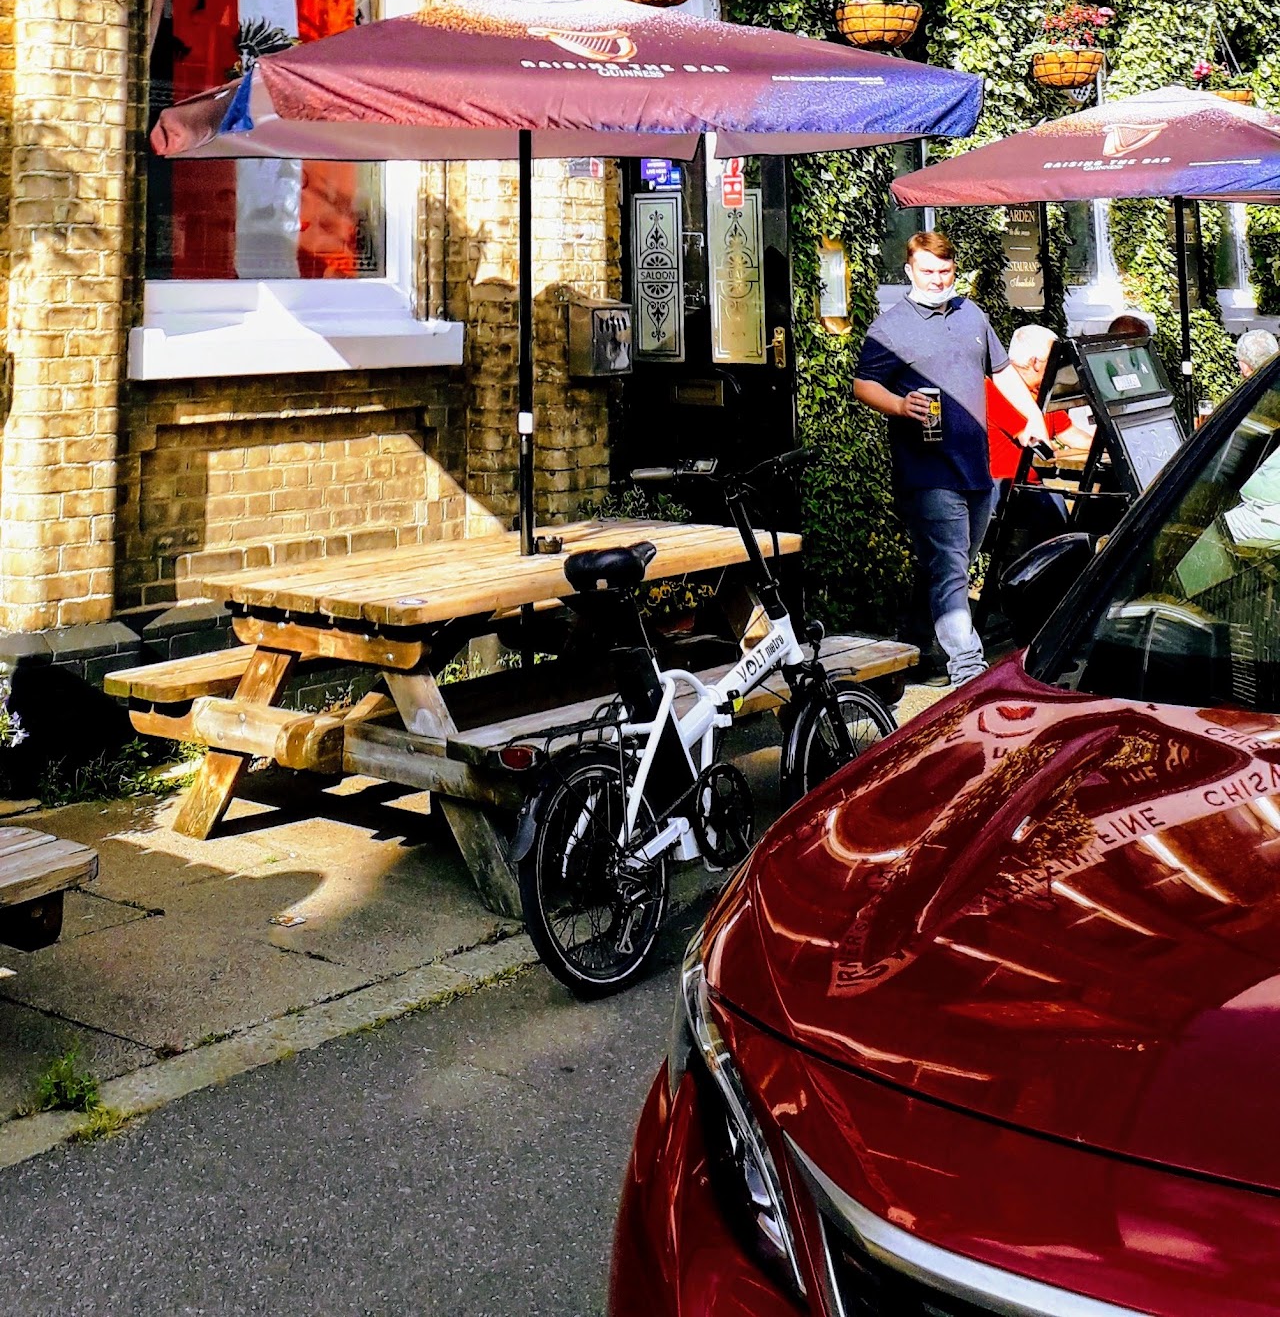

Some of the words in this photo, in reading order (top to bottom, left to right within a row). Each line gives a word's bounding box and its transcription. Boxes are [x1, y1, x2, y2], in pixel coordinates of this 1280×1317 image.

[597, 68, 665, 78] GUINNESS
[640, 270, 675, 280] SALOON
[736, 649, 767, 683] VOLT
[764, 634, 785, 658] metro
